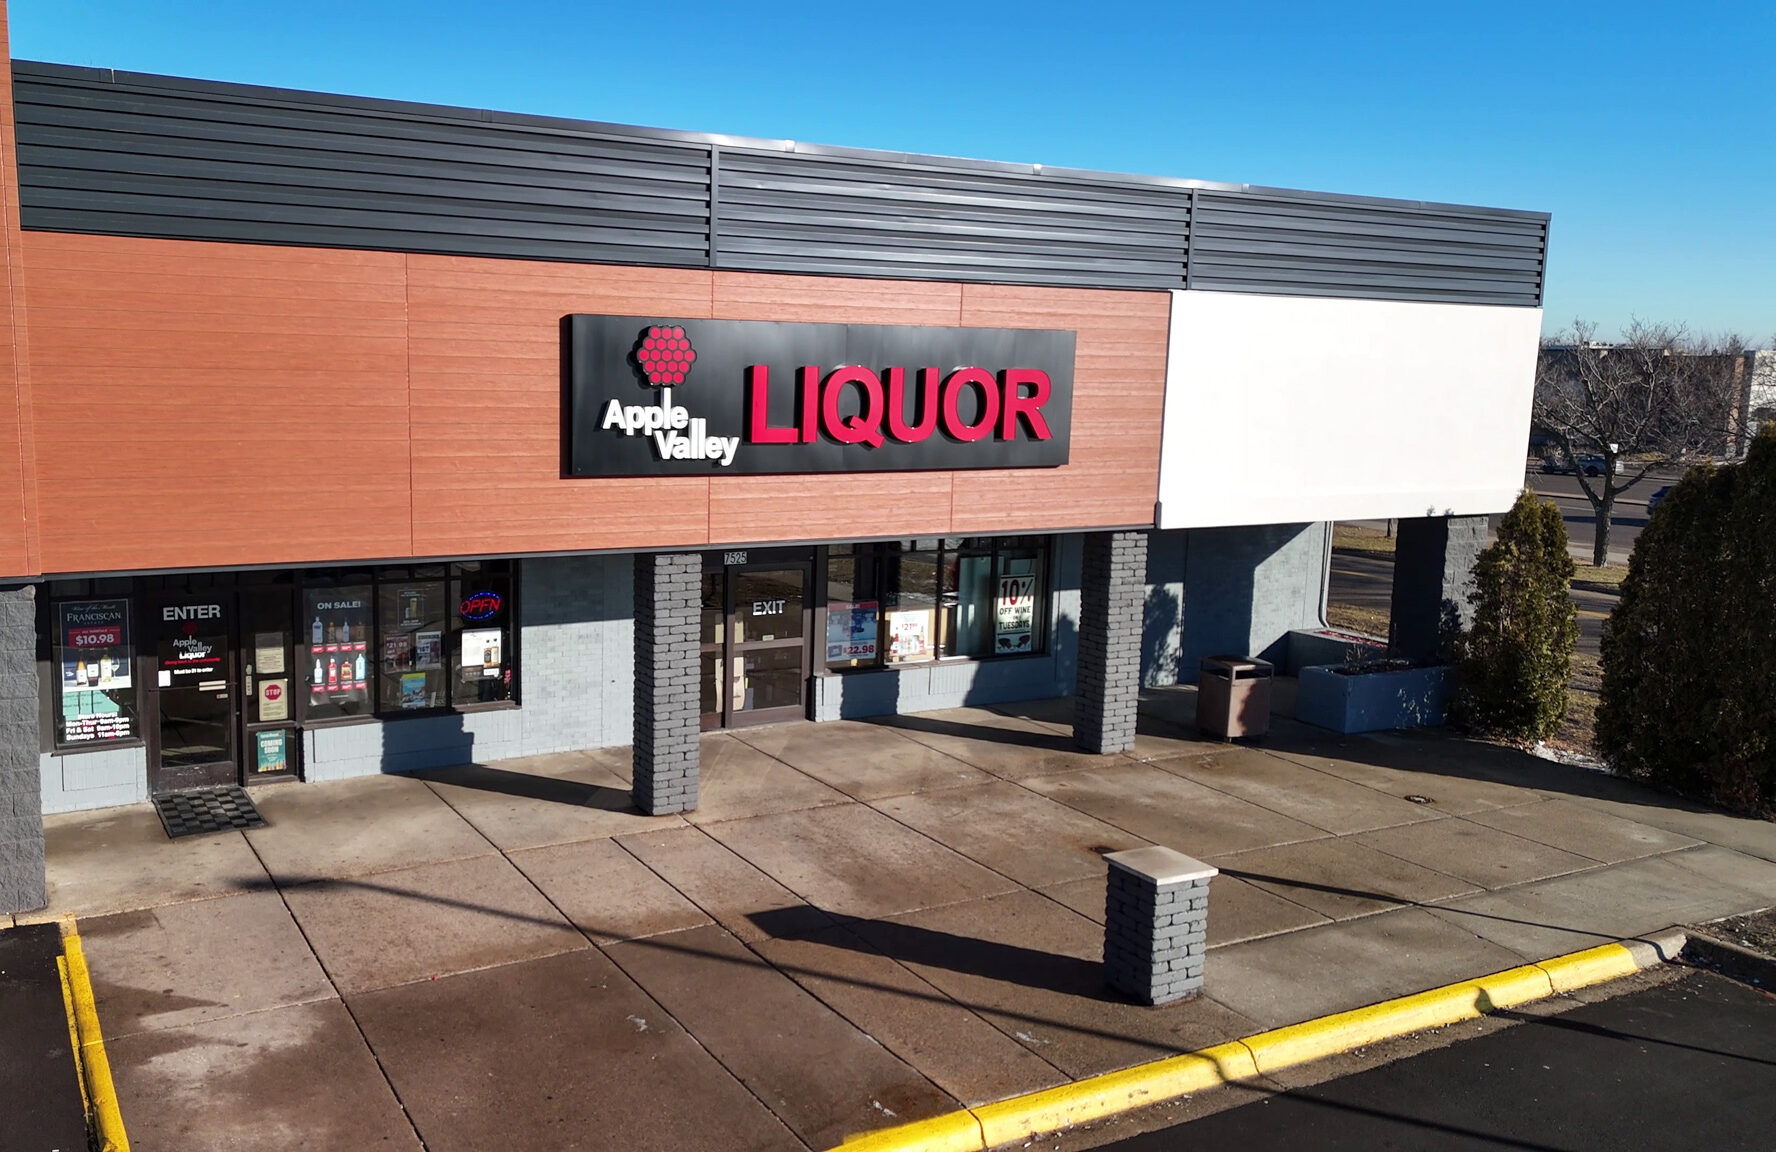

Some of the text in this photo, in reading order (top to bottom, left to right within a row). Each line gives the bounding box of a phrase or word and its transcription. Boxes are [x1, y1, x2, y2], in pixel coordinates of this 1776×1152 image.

[602, 388, 688, 436] Apple
[749, 365, 1053, 449] LIQUOR
[653, 418, 740, 466] Valley
[725, 552, 746, 564] 7525
[1002, 579, 1033, 605] 10%
[334, 601, 360, 609] SALE!
[753, 600, 785, 616] EXIT
[1000, 605, 1031, 615] OFF WINE
[66, 611, 121, 624] FRANCISCAN
[163, 604, 221, 621] ENTER
[999, 620, 1030, 630] TUESDAYS
[75, 634, 114, 646] $10.98
[173, 635, 197, 648] Apple
[188, 641, 212, 653] Valley
[179, 651, 206, 660] Liquor
[266, 689, 281, 697] STOP
